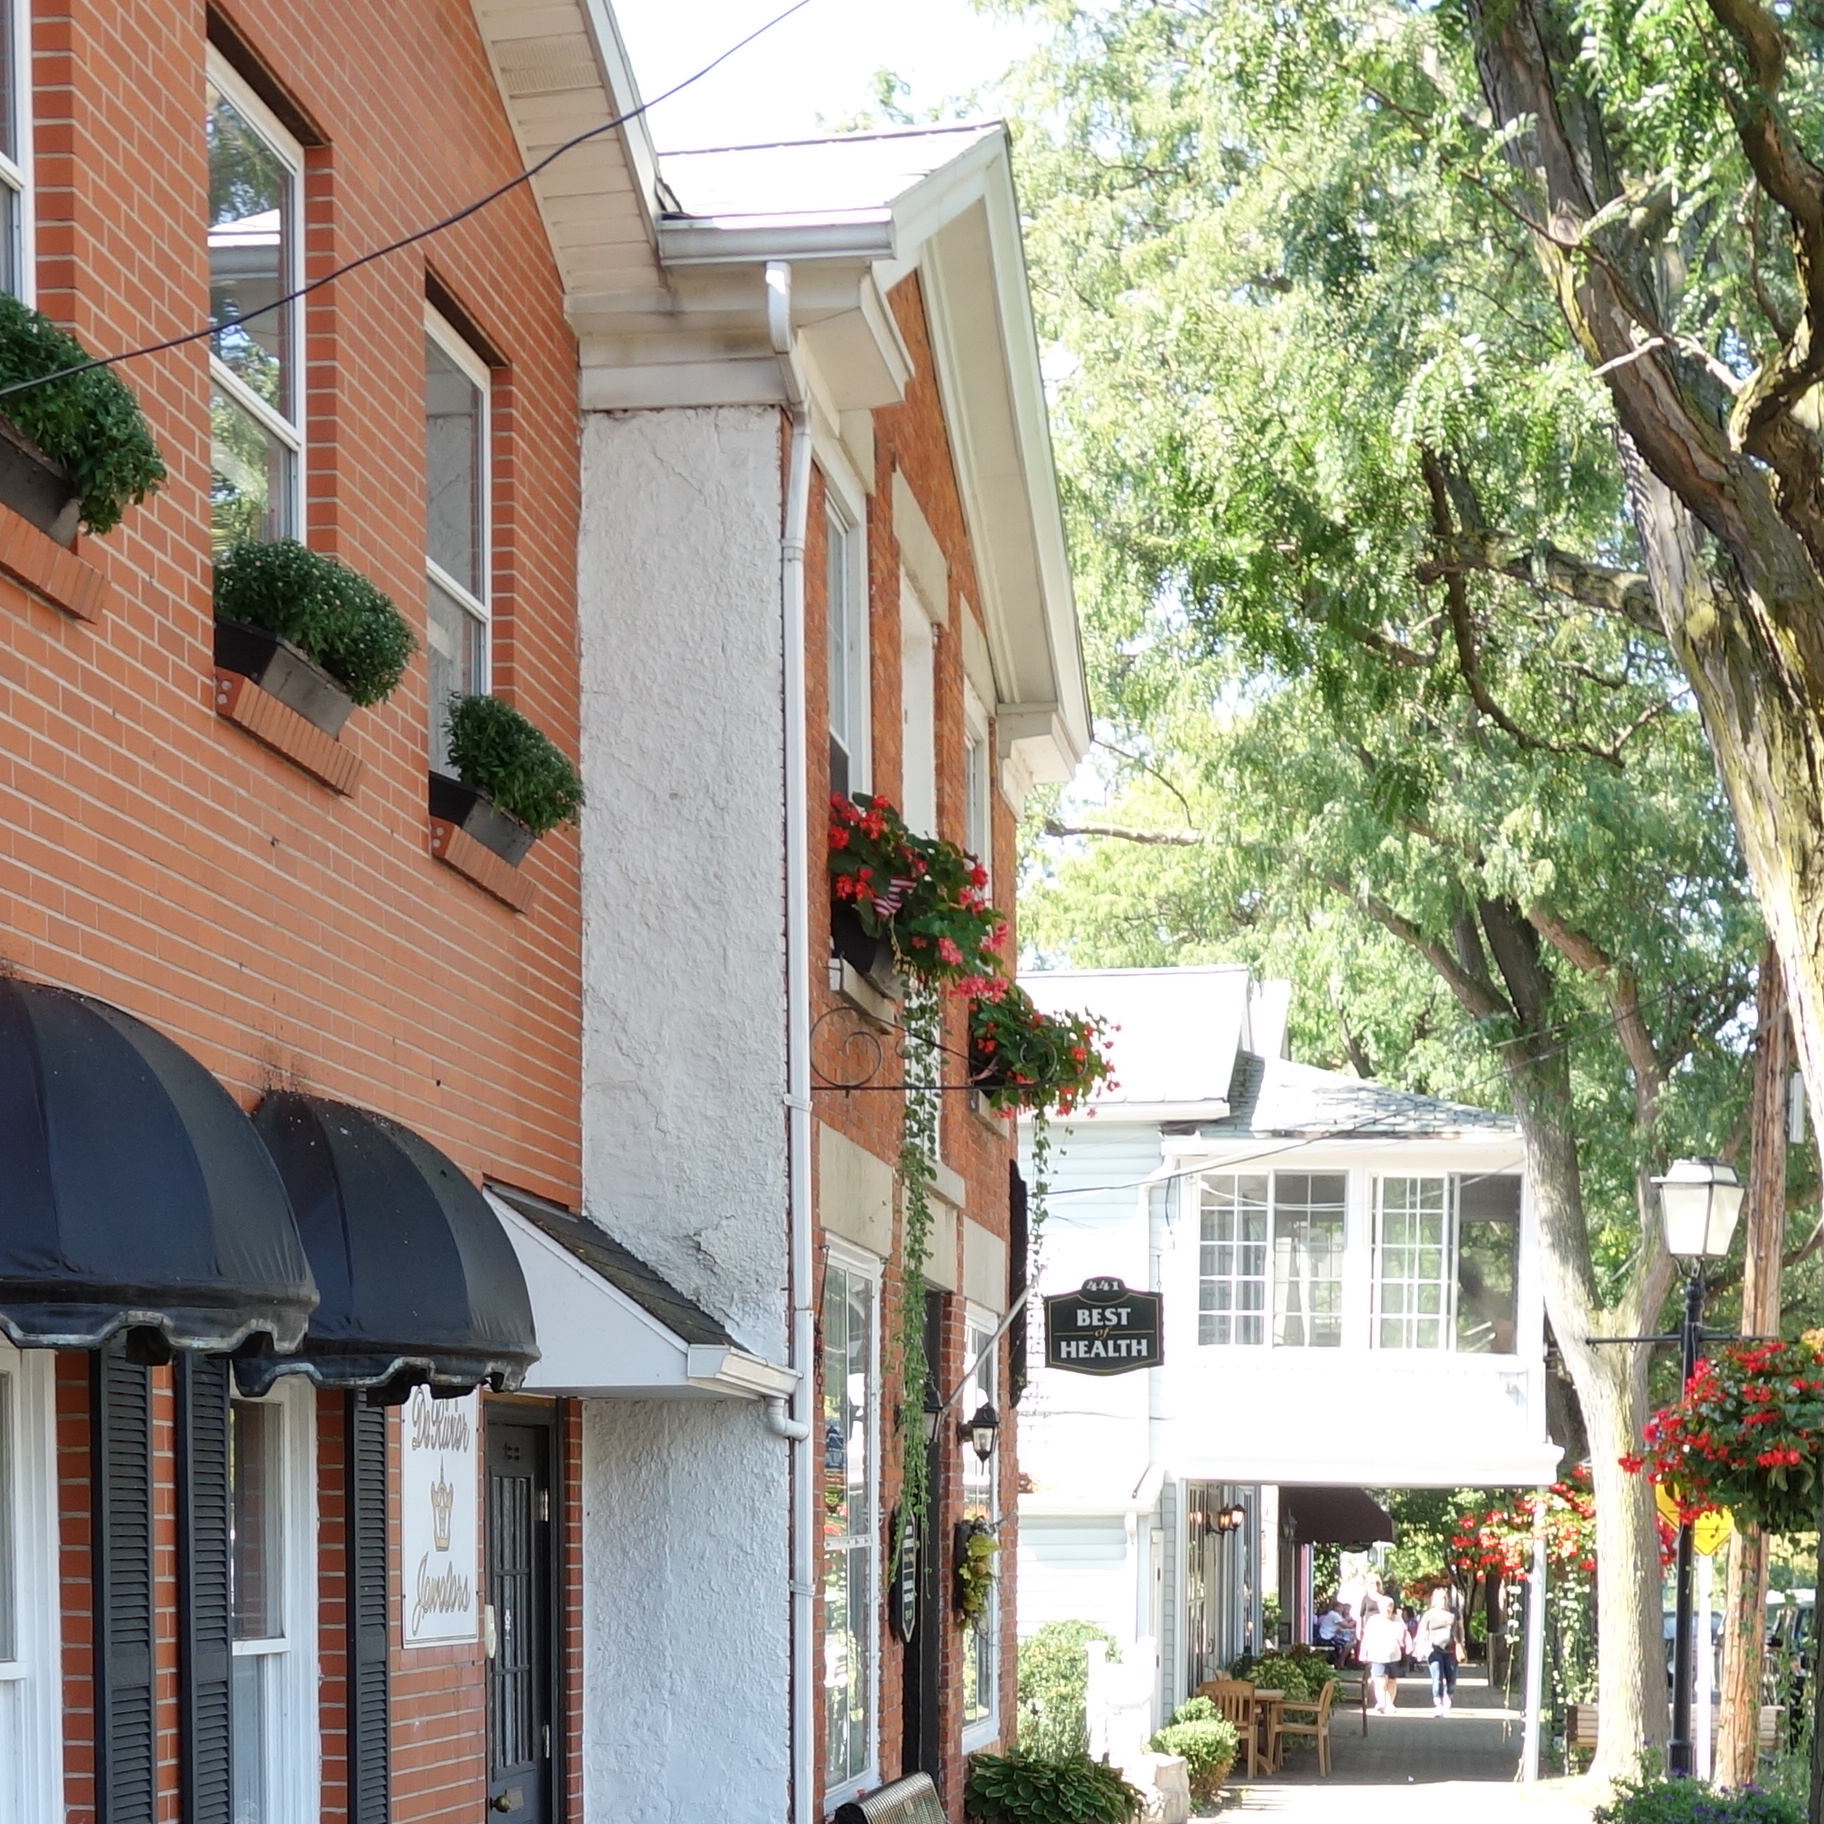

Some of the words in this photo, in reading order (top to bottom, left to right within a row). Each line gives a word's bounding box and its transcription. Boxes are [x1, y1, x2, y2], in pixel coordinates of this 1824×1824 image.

[1086, 1280, 1120, 1292] 441
[1076, 1308, 1131, 1327] BEST
[1094, 1327, 1112, 1340] of
[1060, 1339, 1148, 1359] HEALTH
